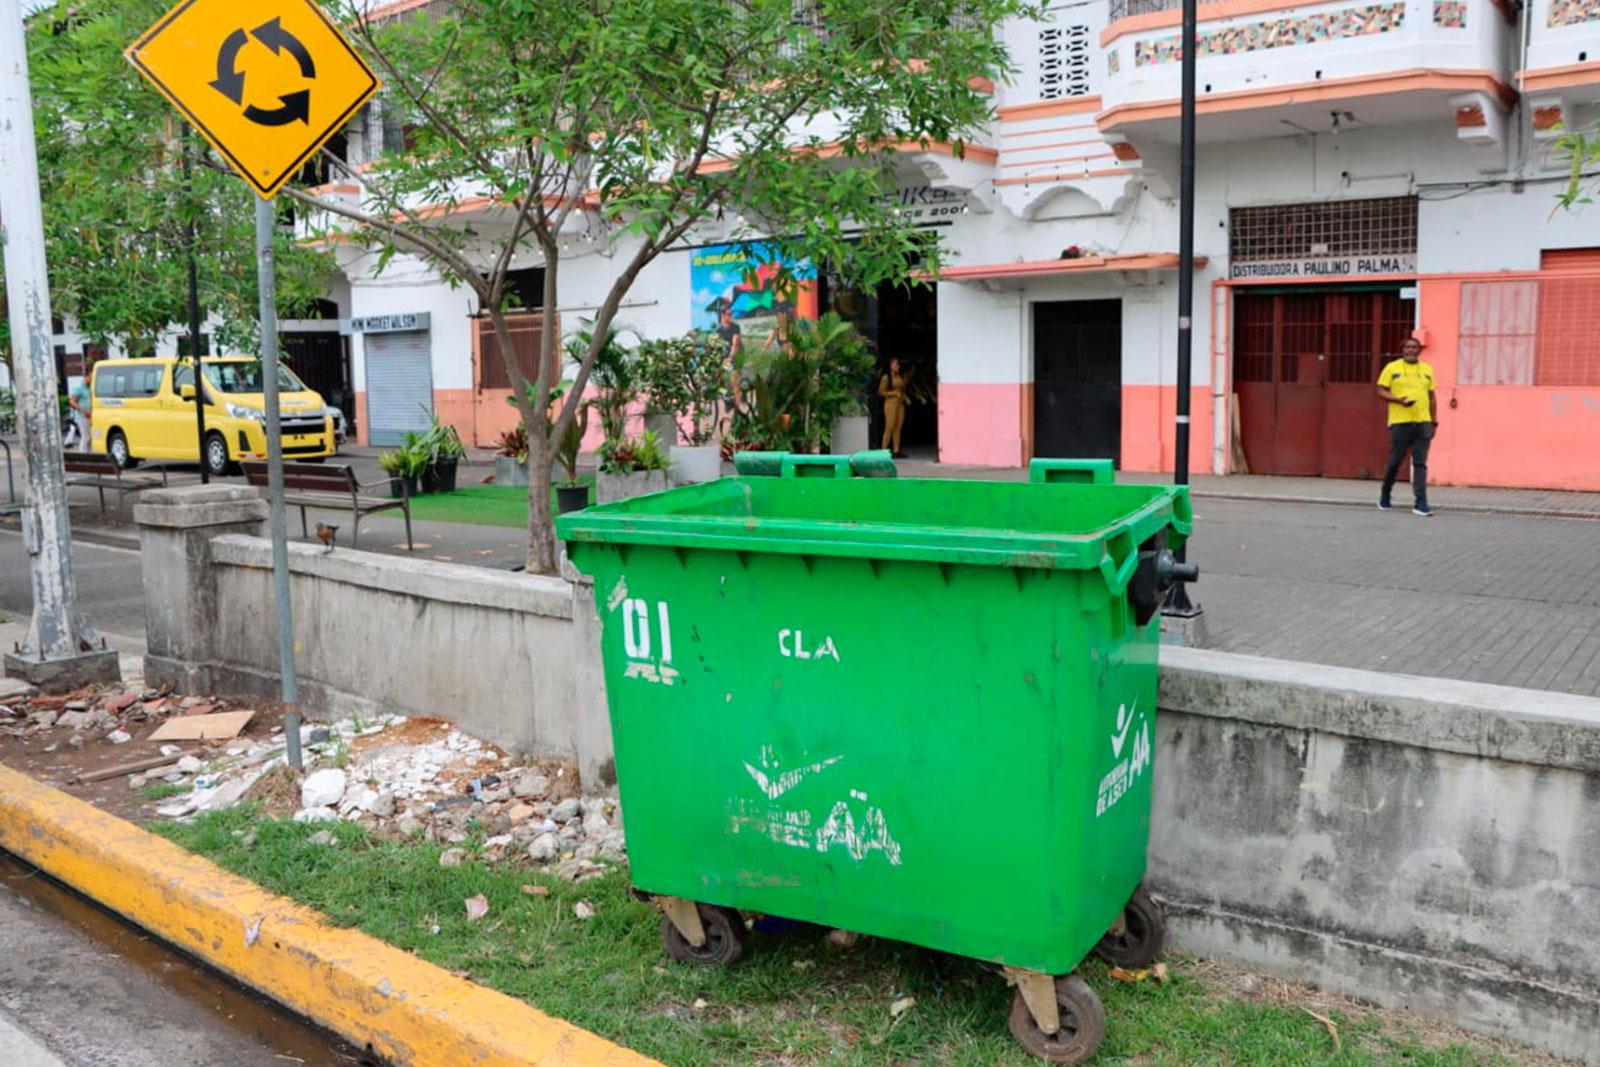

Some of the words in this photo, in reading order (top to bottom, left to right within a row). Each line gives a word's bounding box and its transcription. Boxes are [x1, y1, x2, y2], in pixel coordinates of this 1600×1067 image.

[1233, 261, 1299, 277] DISTRIBUIDORA
[1304, 261, 1350, 275] PAULINO
[1357, 258, 1400, 273] PALMA
[778, 628, 840, 662] CLA
